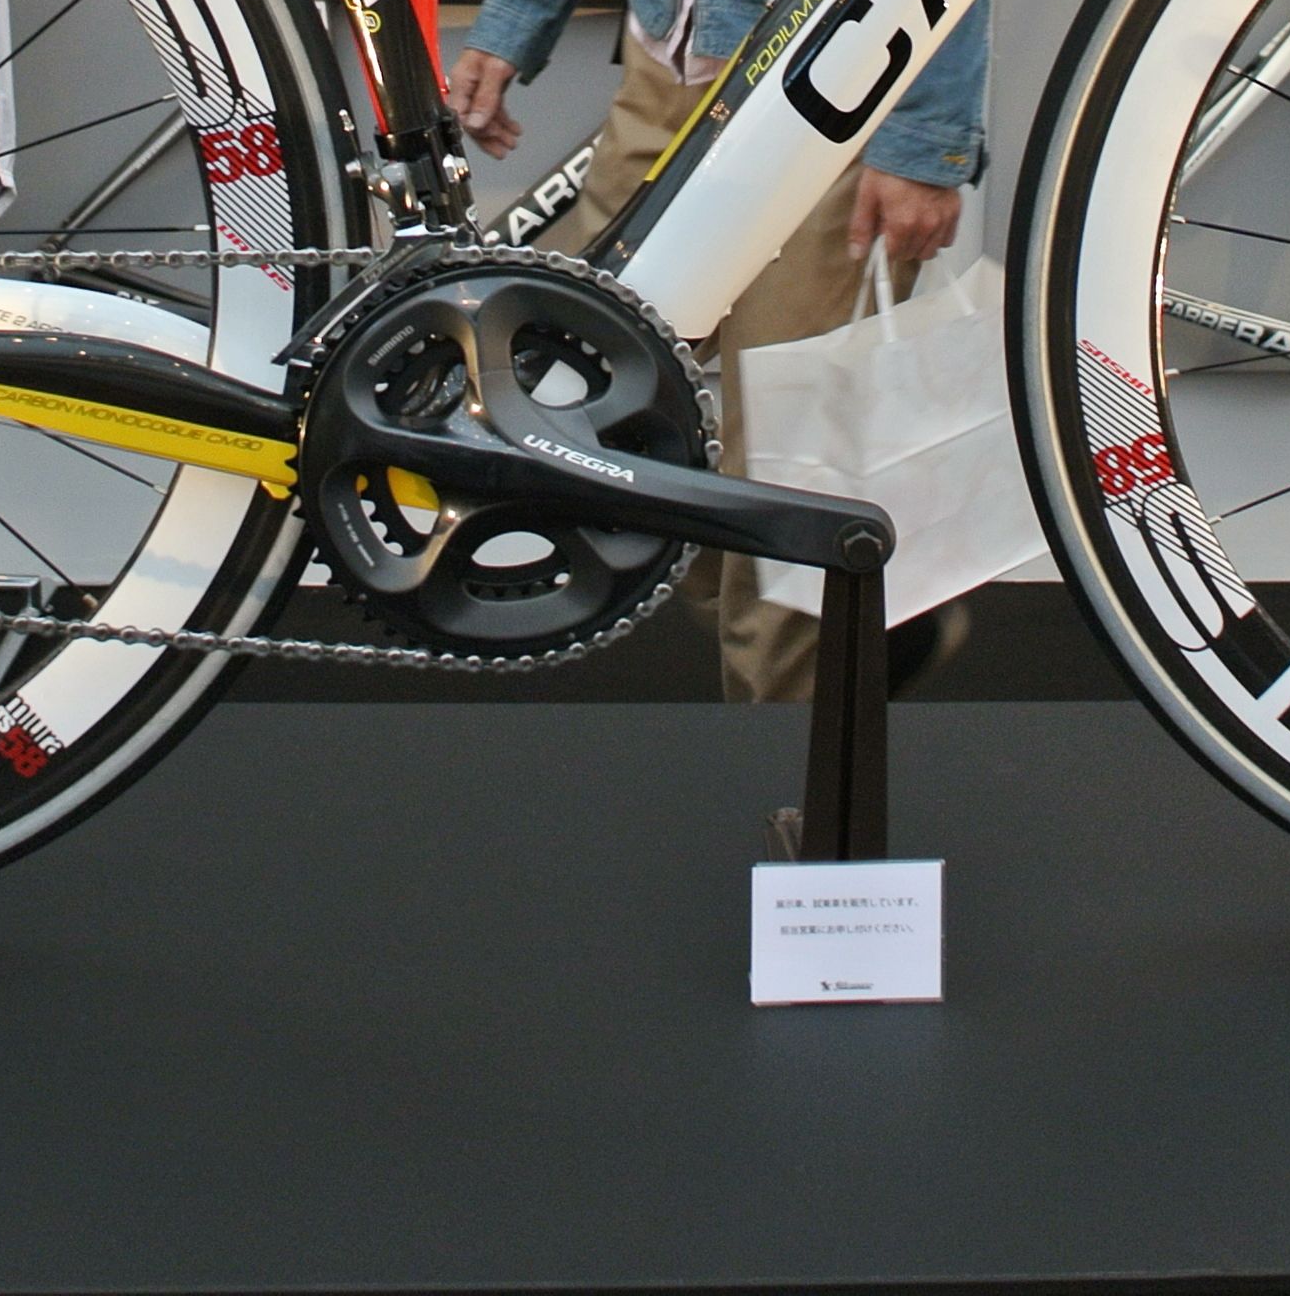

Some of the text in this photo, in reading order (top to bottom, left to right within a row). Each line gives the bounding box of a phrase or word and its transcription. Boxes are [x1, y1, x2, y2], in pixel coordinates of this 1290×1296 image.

[199, 123, 284, 185] 58
[367, 324, 415, 368] SHIMANO
[1076, 339, 1154, 396] URSUS
[75, 404, 205, 442] MONOCOQUE
[206, 430, 265, 453] CM30
[522, 433, 635, 484] ULTEGRA
[1093, 432, 1175, 497] 58
[4, 695, 65, 756] miura
